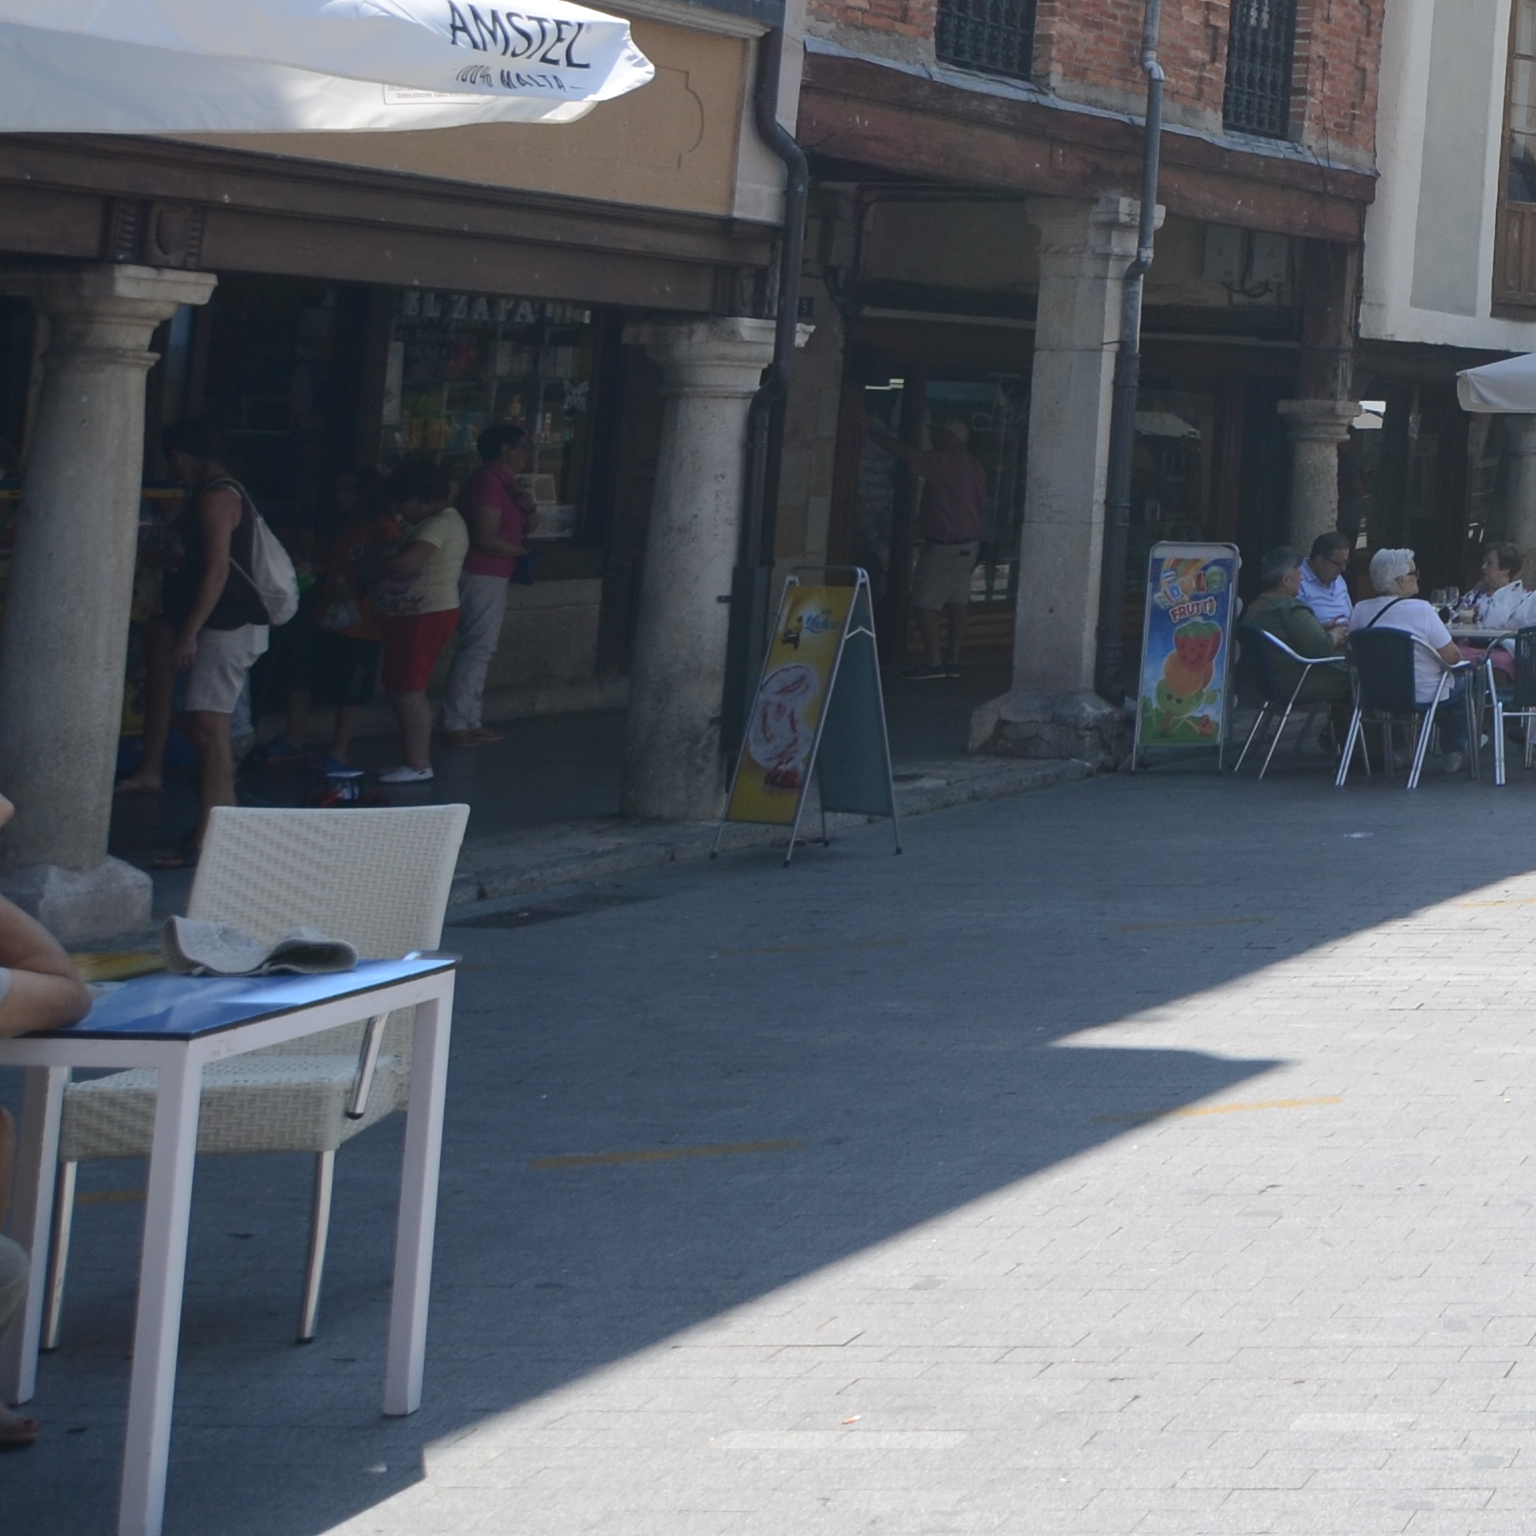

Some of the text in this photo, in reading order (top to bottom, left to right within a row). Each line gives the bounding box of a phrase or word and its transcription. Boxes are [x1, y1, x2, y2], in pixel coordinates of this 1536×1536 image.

[446, 0, 591, 69] AMSTEL
[456, 64, 567, 93] 100% MALTA
